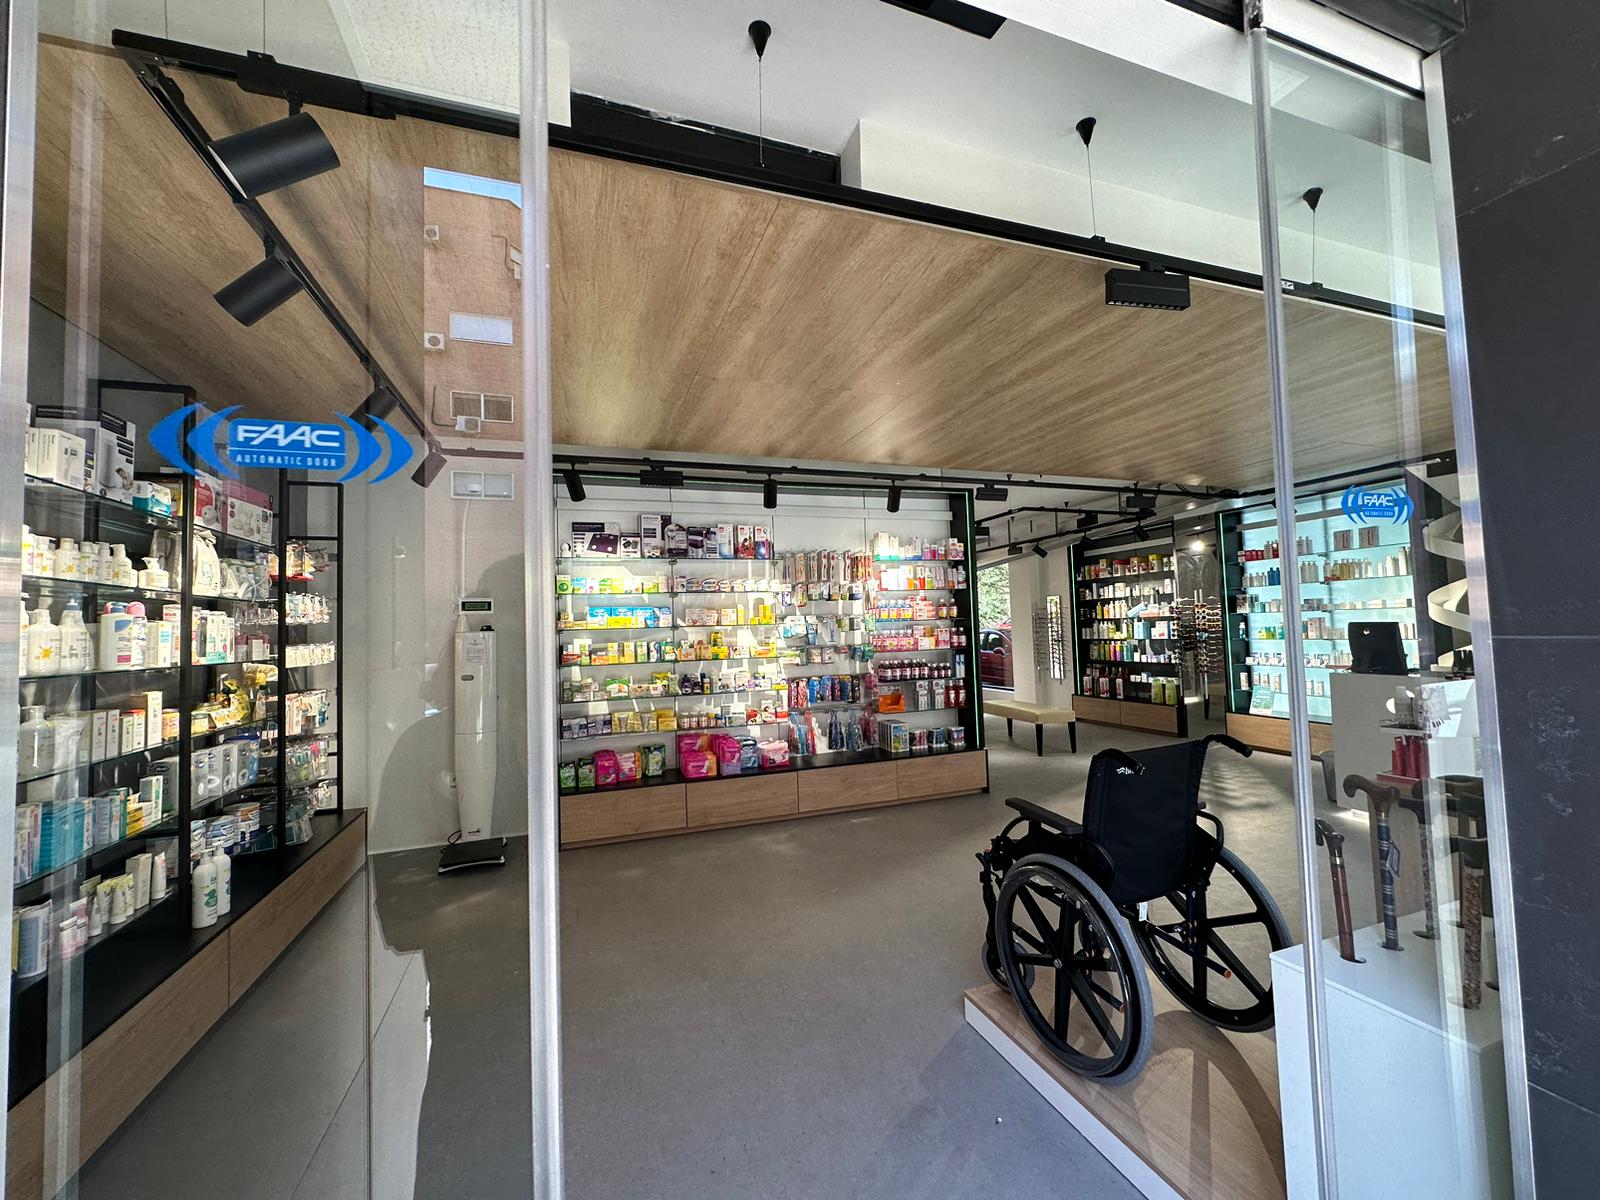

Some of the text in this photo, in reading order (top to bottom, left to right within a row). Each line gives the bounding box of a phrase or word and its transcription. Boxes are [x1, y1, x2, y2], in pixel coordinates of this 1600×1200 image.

[237, 424, 340, 448] FAAC
[235, 454, 337, 467] AUTOMATIC DOOR
[1364, 494, 1394, 507] FAAC
